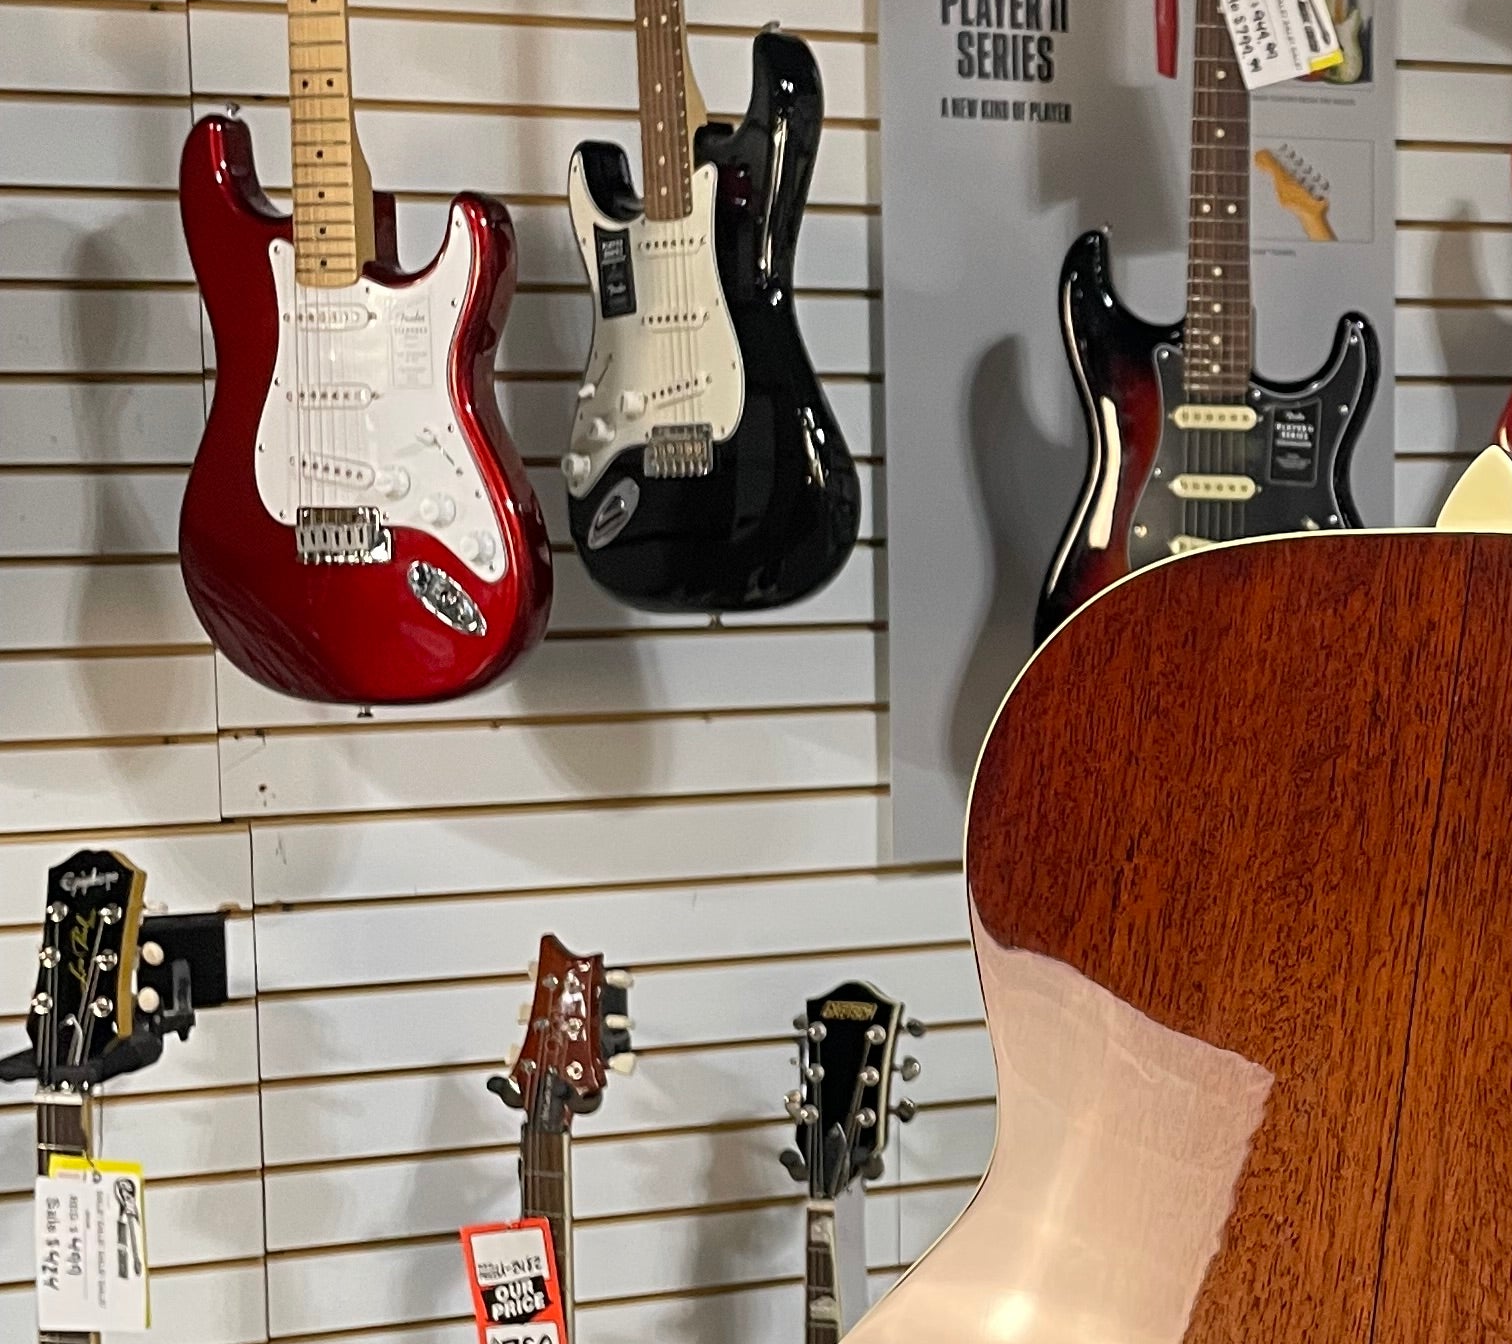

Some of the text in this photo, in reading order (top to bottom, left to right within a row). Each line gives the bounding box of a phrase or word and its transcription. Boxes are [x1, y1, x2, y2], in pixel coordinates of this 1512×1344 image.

[957, 30, 1055, 83] SERIES
[495, 1280, 534, 1302] OUR
[491, 1292, 545, 1321] PRICE
